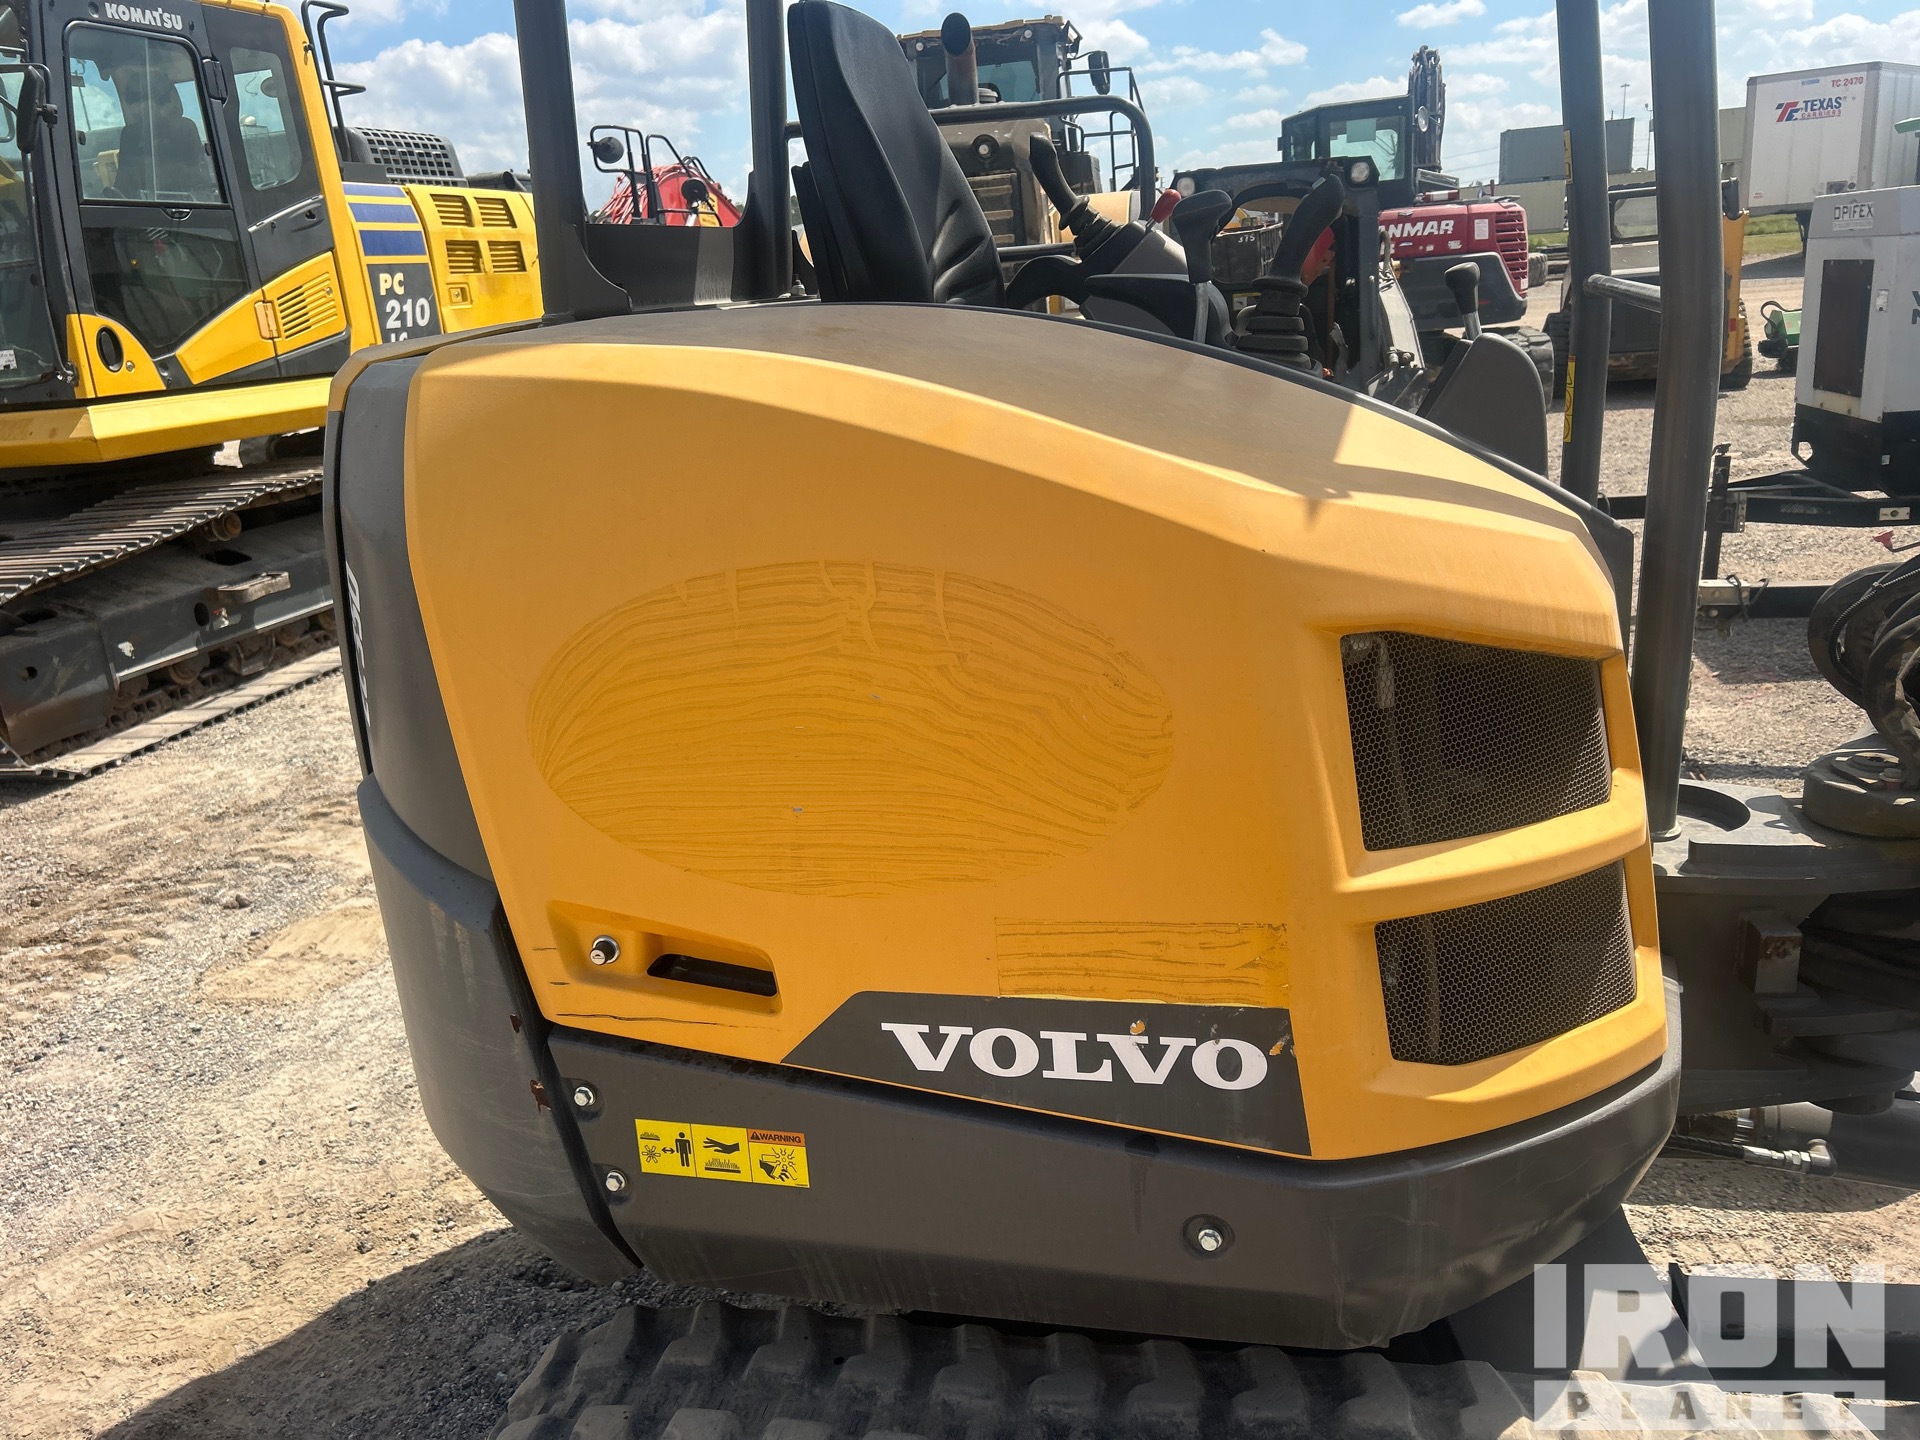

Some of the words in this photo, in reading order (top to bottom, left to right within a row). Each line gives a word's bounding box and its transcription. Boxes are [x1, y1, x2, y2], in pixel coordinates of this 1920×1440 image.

[104, 2, 183, 31] KOMATSU
[1831, 79, 1841, 88] TC
[1843, 76, 1864, 87] 2470
[1803, 96, 1842, 112] TEXAS
[1801, 110, 1842, 119] CARRIERS
[379, 272, 405, 296] PC
[385, 297, 431, 330] 210
[881, 1022, 1268, 1091] VOLVO
[760, 1132, 802, 1144] WARNING
